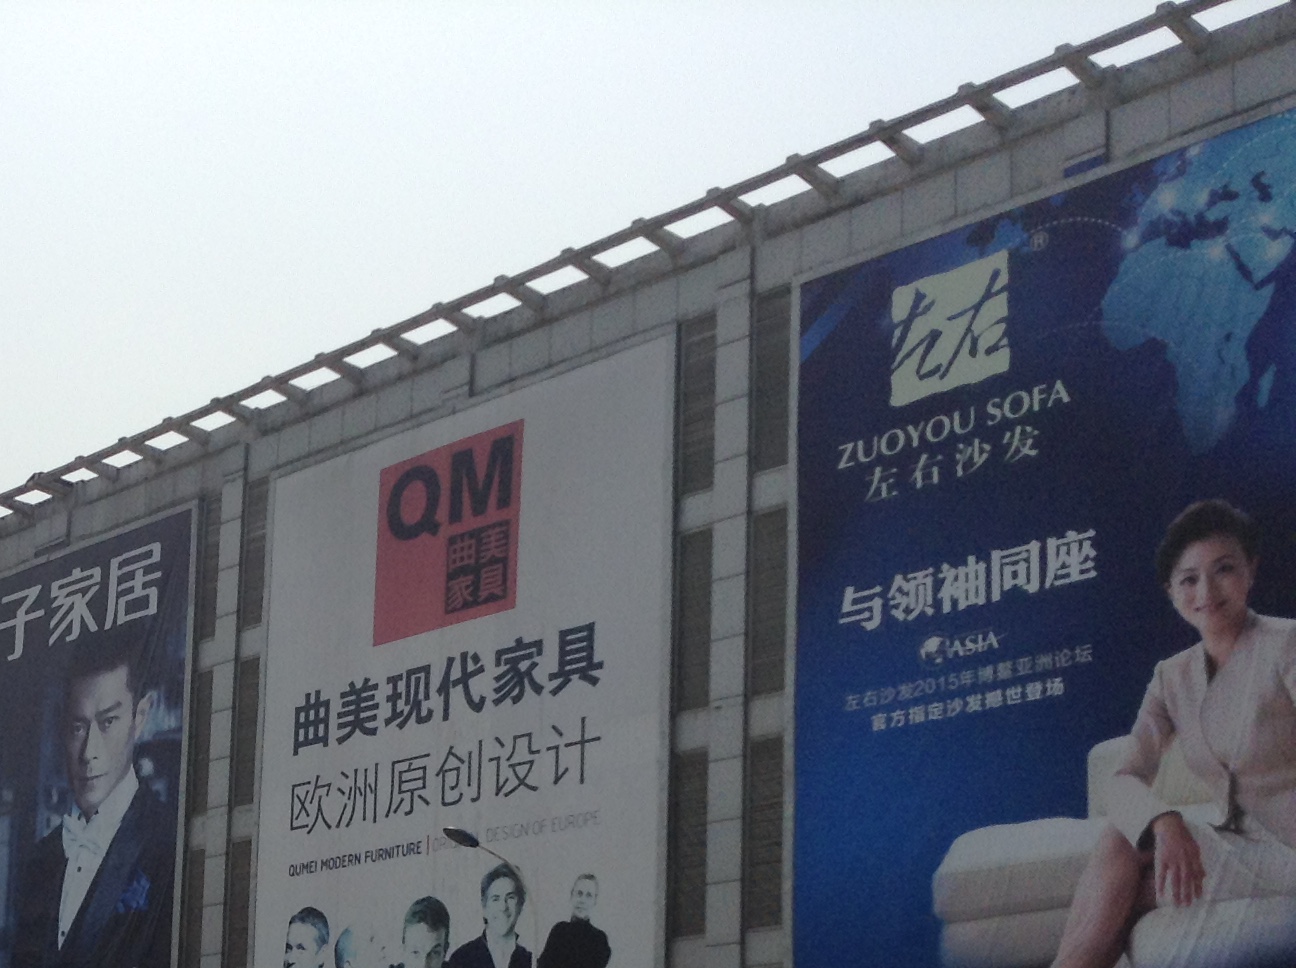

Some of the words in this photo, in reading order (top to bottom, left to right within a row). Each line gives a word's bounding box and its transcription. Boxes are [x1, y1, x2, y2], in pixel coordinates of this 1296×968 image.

[837, 405, 976, 470] ZUOYOU
[987, 379, 1071, 426] SOFA
[864, 424, 1040, 501] 左右沙发
[386, 434, 516, 541] QM
[838, 528, 1097, 631] 与领袖同座
[292, 621, 605, 757] 曲美现代家具
[289, 716, 602, 835] 欧洲原创设计
[288, 861, 318, 877] QUMEI
[320, 852, 362, 872] MODERN
[364, 841, 422, 865] FURNITURE
